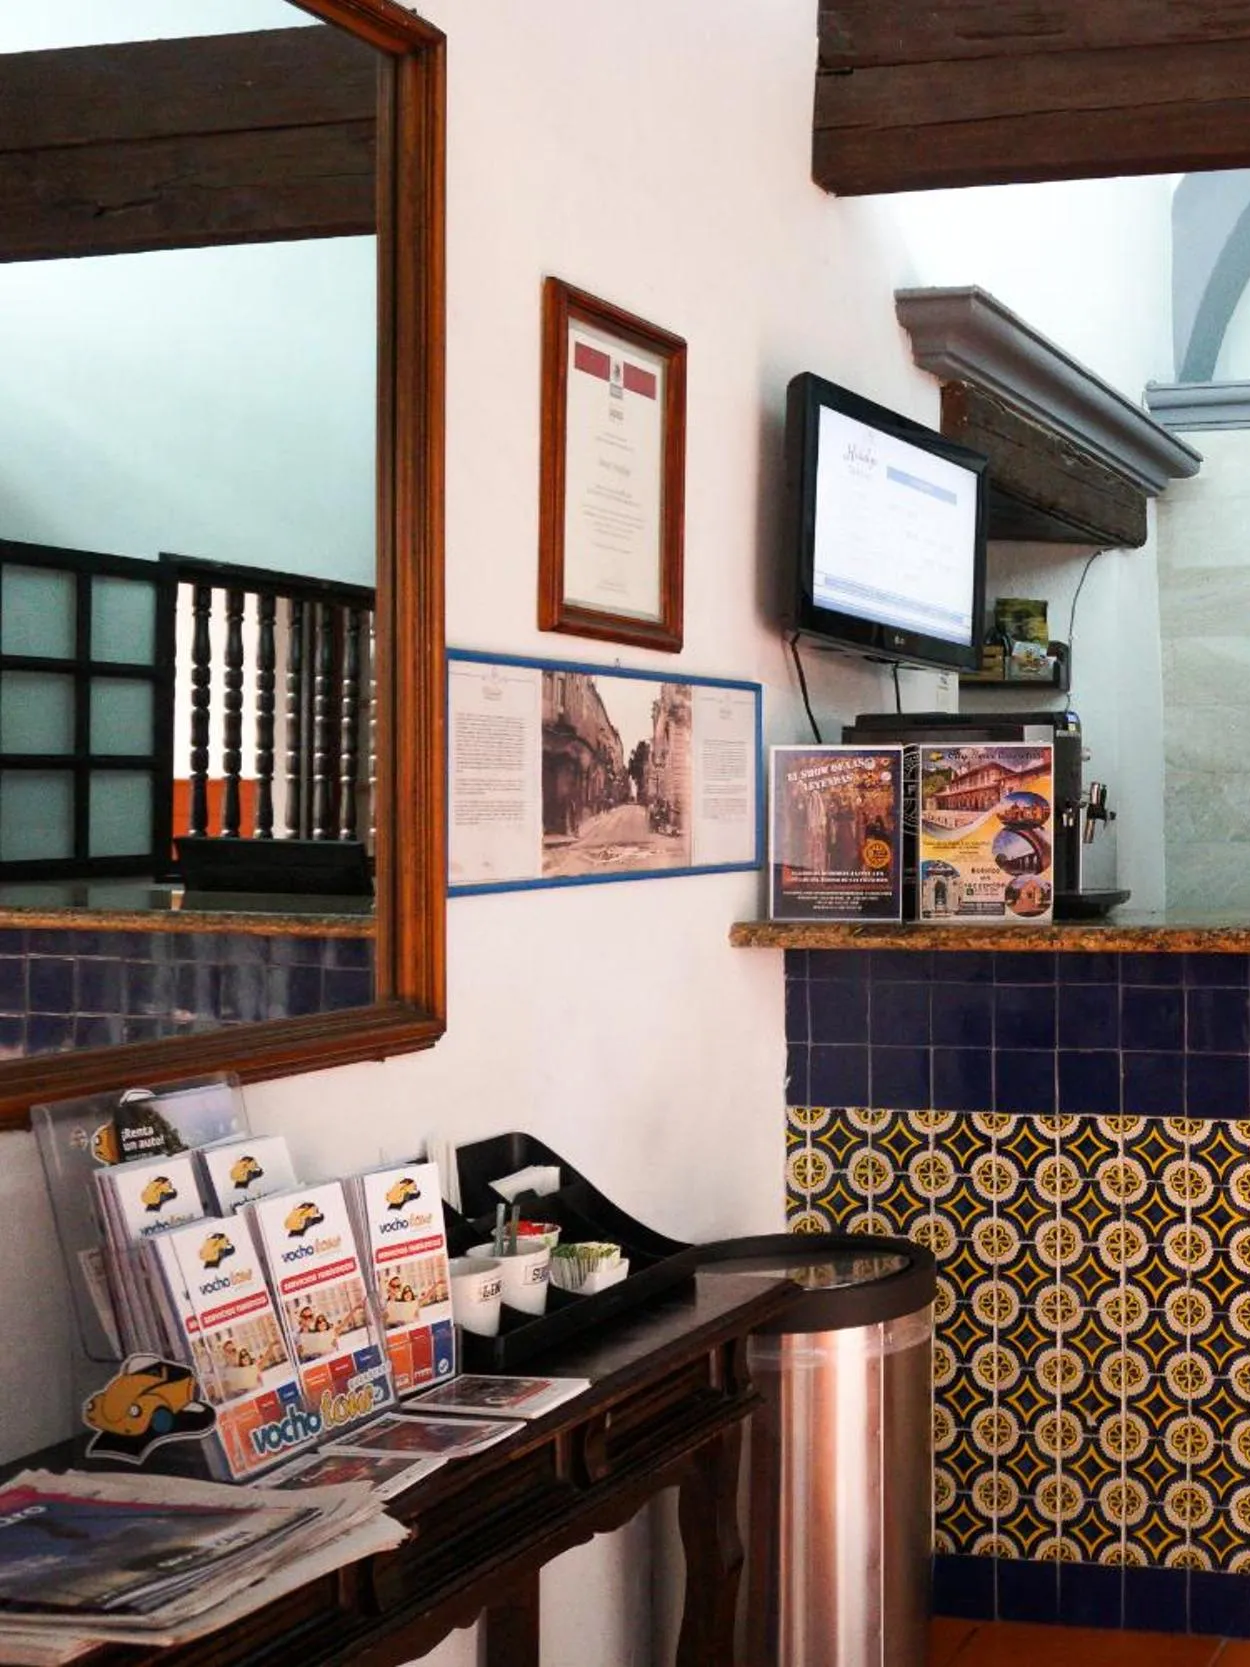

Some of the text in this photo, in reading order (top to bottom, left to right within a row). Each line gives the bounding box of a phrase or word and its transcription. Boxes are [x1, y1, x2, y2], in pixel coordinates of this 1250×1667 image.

[800, 765, 829, 778] SHOW
[121, 1125, 154, 1142] ¡Renta
[123, 1134, 166, 1151] un auto!
[380, 1219, 409, 1234] vocho
[281, 1246, 314, 1262] vocho
[200, 1276, 230, 1294] vocho
[252, 1406, 321, 1455] vocho
